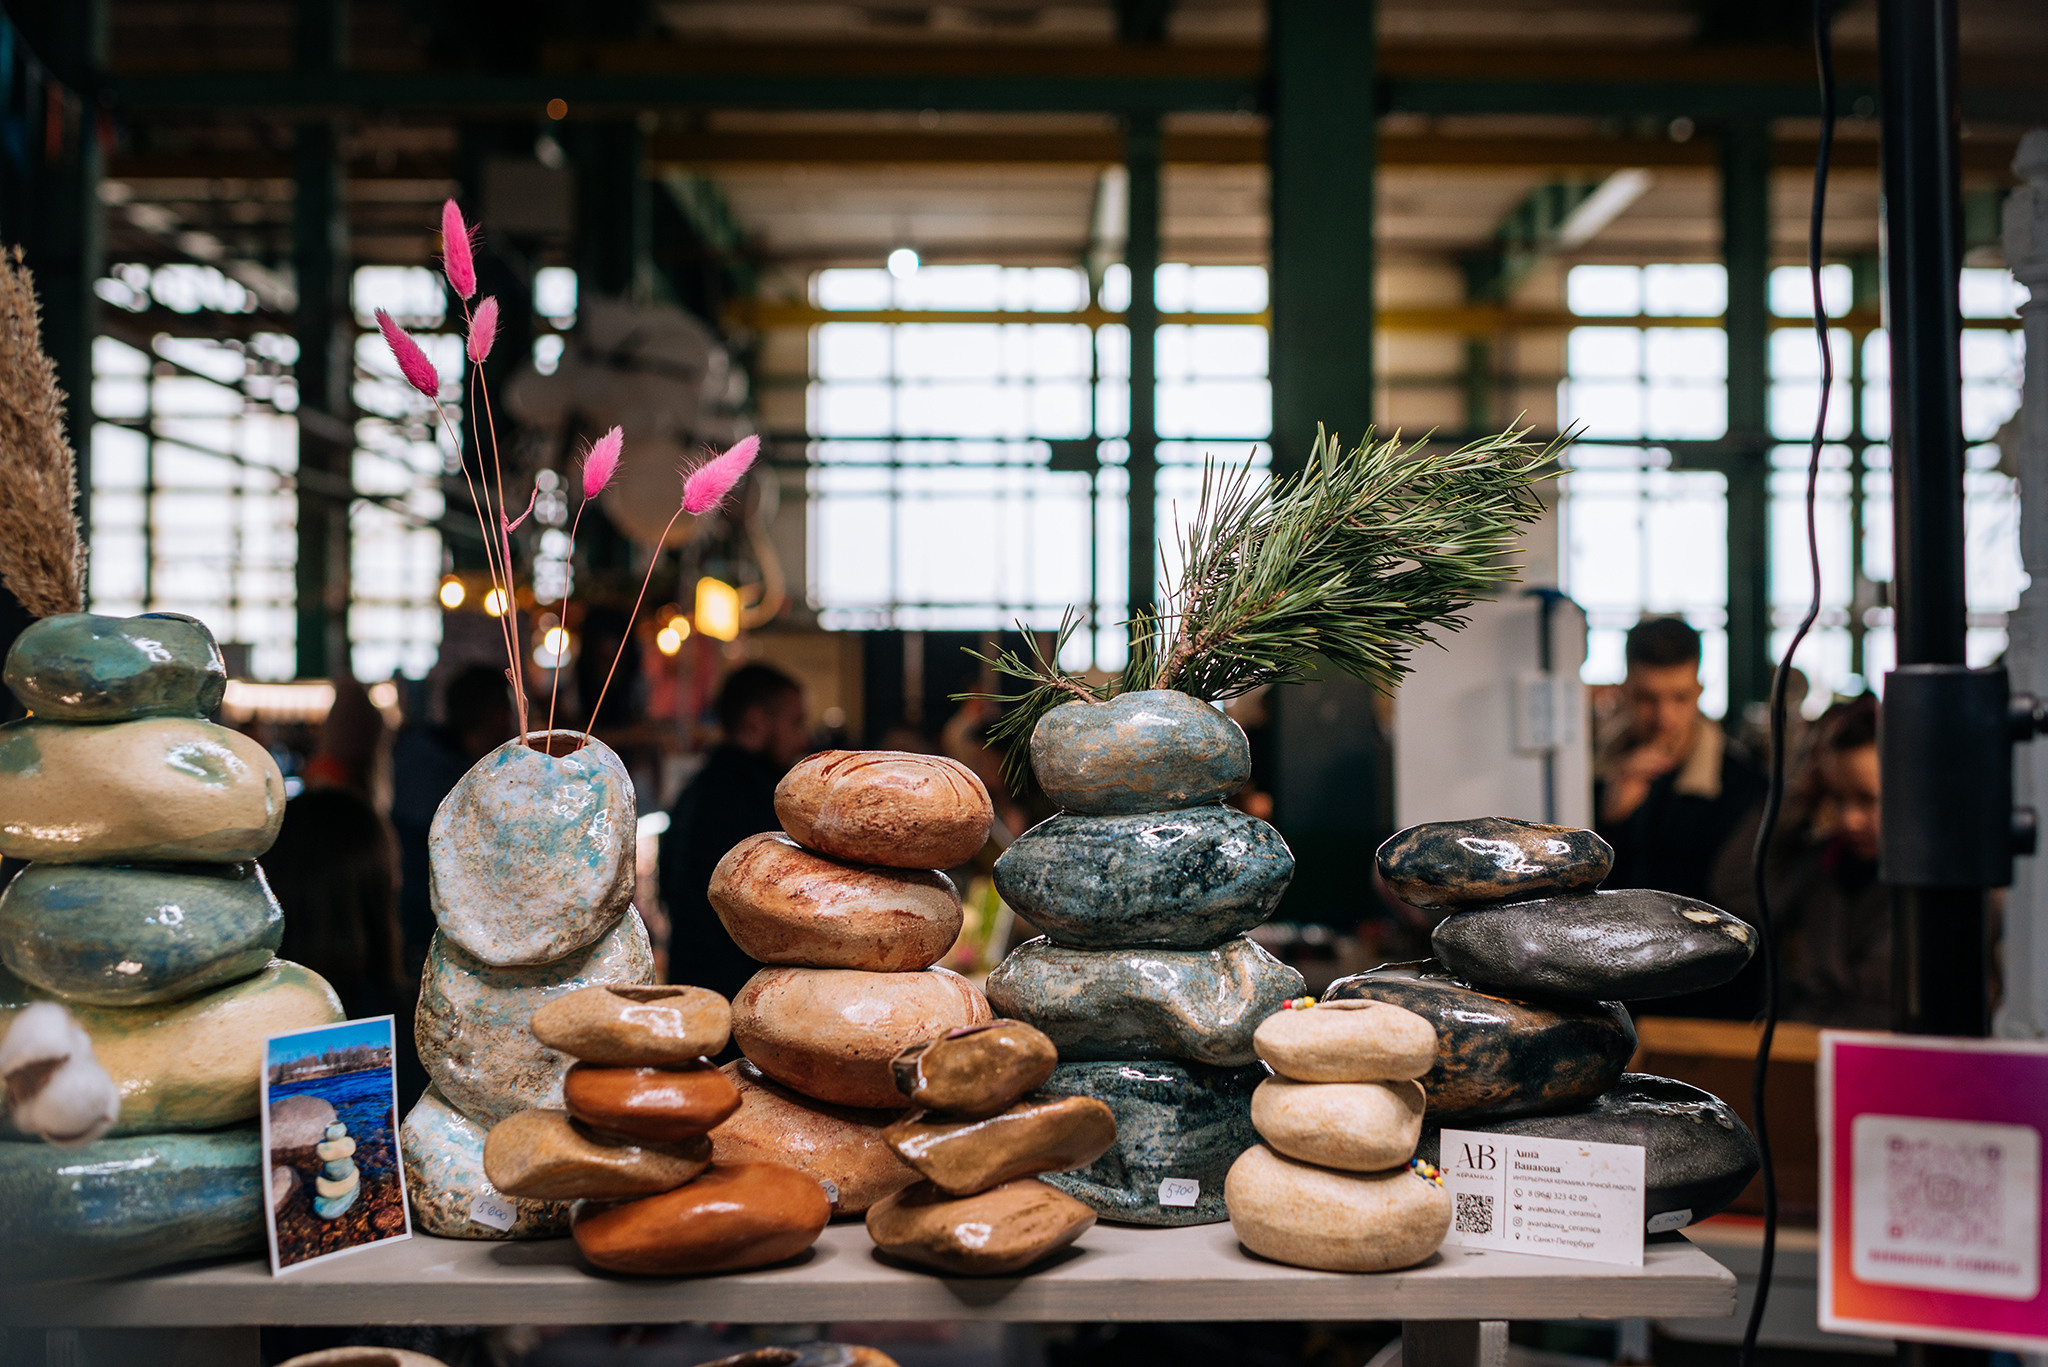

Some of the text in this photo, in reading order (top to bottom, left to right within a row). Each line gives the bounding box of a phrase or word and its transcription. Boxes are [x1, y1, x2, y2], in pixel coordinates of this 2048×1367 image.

[1514, 1149, 1539, 1159] Анна
[1514, 1161, 1561, 1173] Ванакова
[1166, 1182, 1194, 1199] 5700
